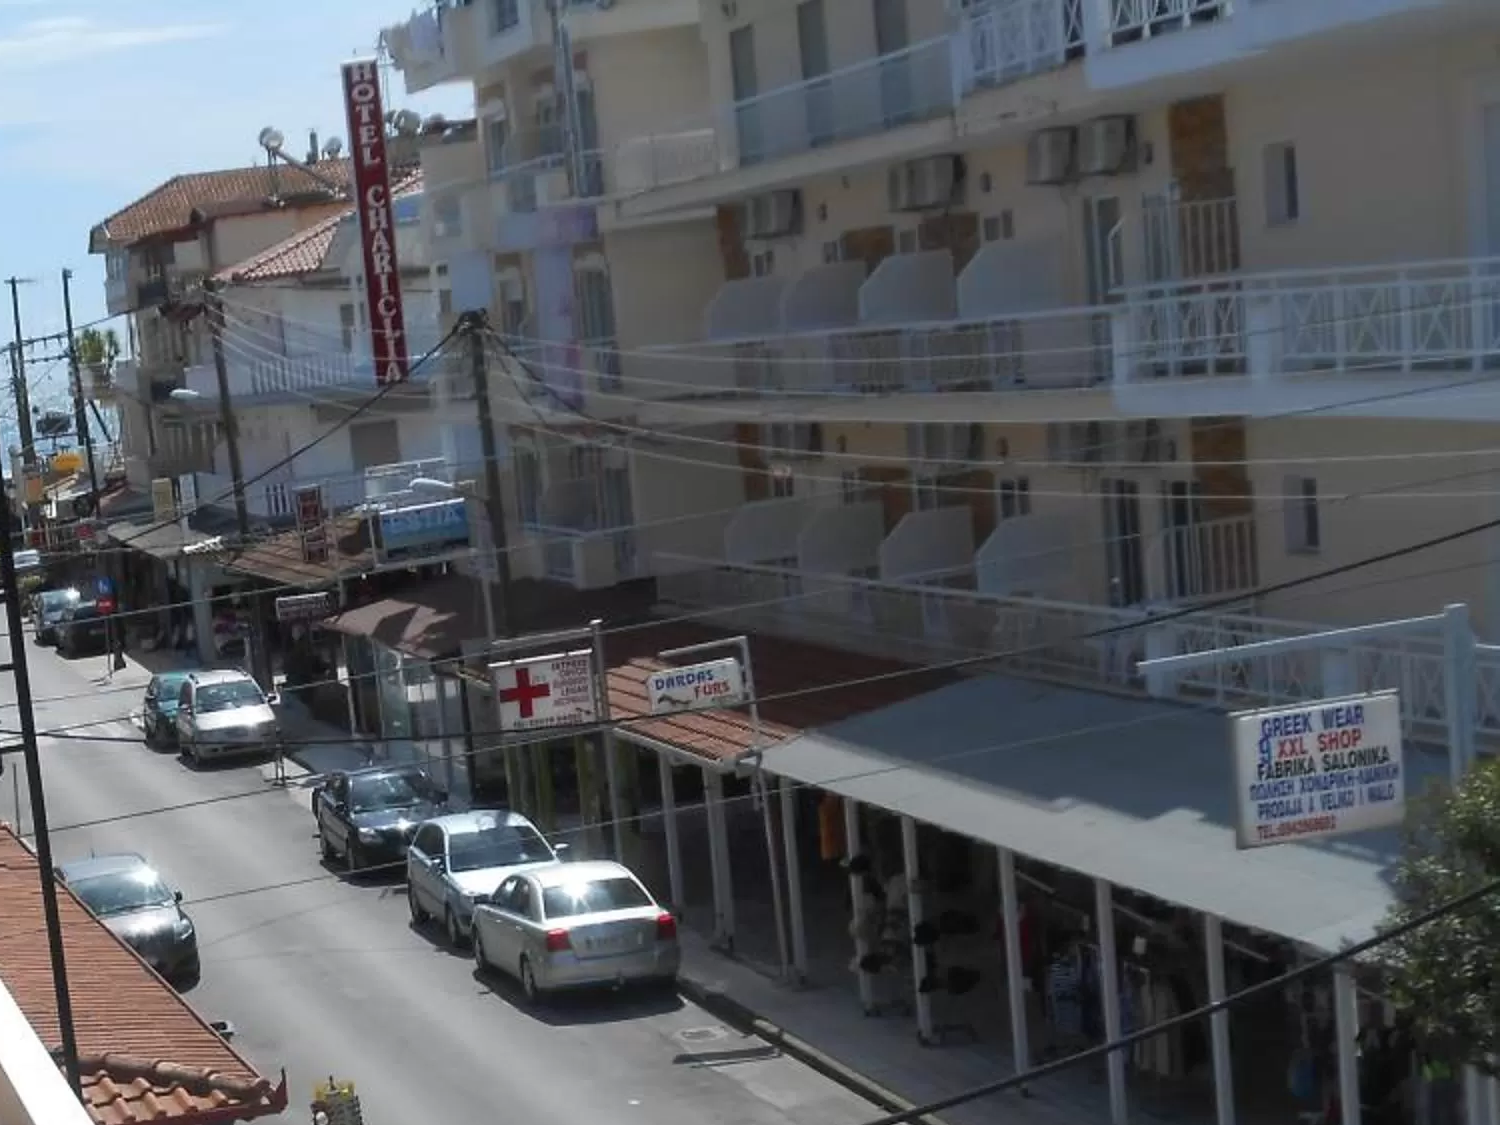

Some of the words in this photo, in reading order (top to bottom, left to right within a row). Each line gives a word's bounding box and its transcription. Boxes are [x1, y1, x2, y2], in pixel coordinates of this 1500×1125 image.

[352, 62, 381, 166] HOTEL
[655, 669, 714, 691] DARDAS
[694, 681, 731, 700] FURS
[1261, 712, 1313, 737] GREEK
[1321, 704, 1365, 729] WEAR
[1277, 735, 1309, 758] XXL
[1317, 728, 1362, 752] SHOP
[1257, 757, 1316, 781] FABRIKA
[1322, 745, 1391, 772] SALONIKA
